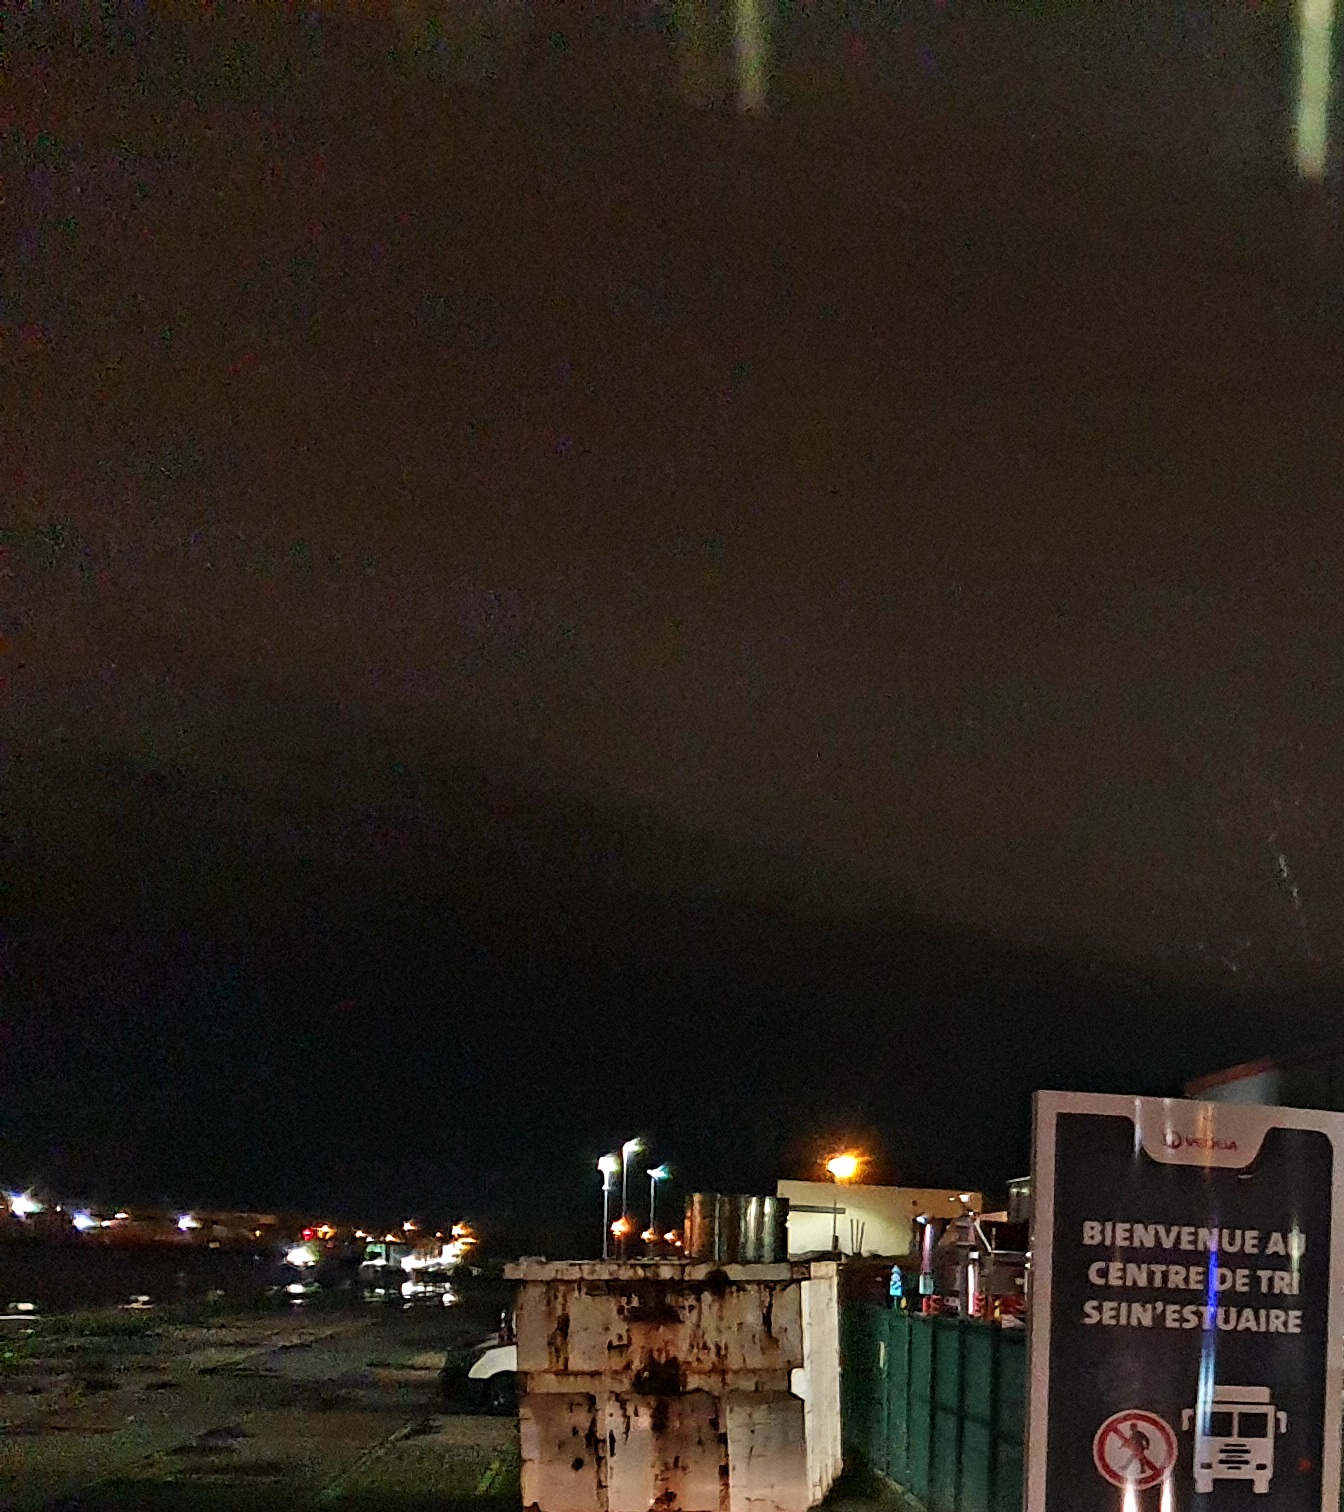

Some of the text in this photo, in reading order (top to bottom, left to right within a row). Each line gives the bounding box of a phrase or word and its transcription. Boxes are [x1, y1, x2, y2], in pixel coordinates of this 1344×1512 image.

[1082, 1220, 1307, 1257] BIENVENUE AU
[1087, 1260, 1300, 1295] CENTRE DE TRI
[1081, 1299, 1303, 1334] SEIN'ESTUAIRE
